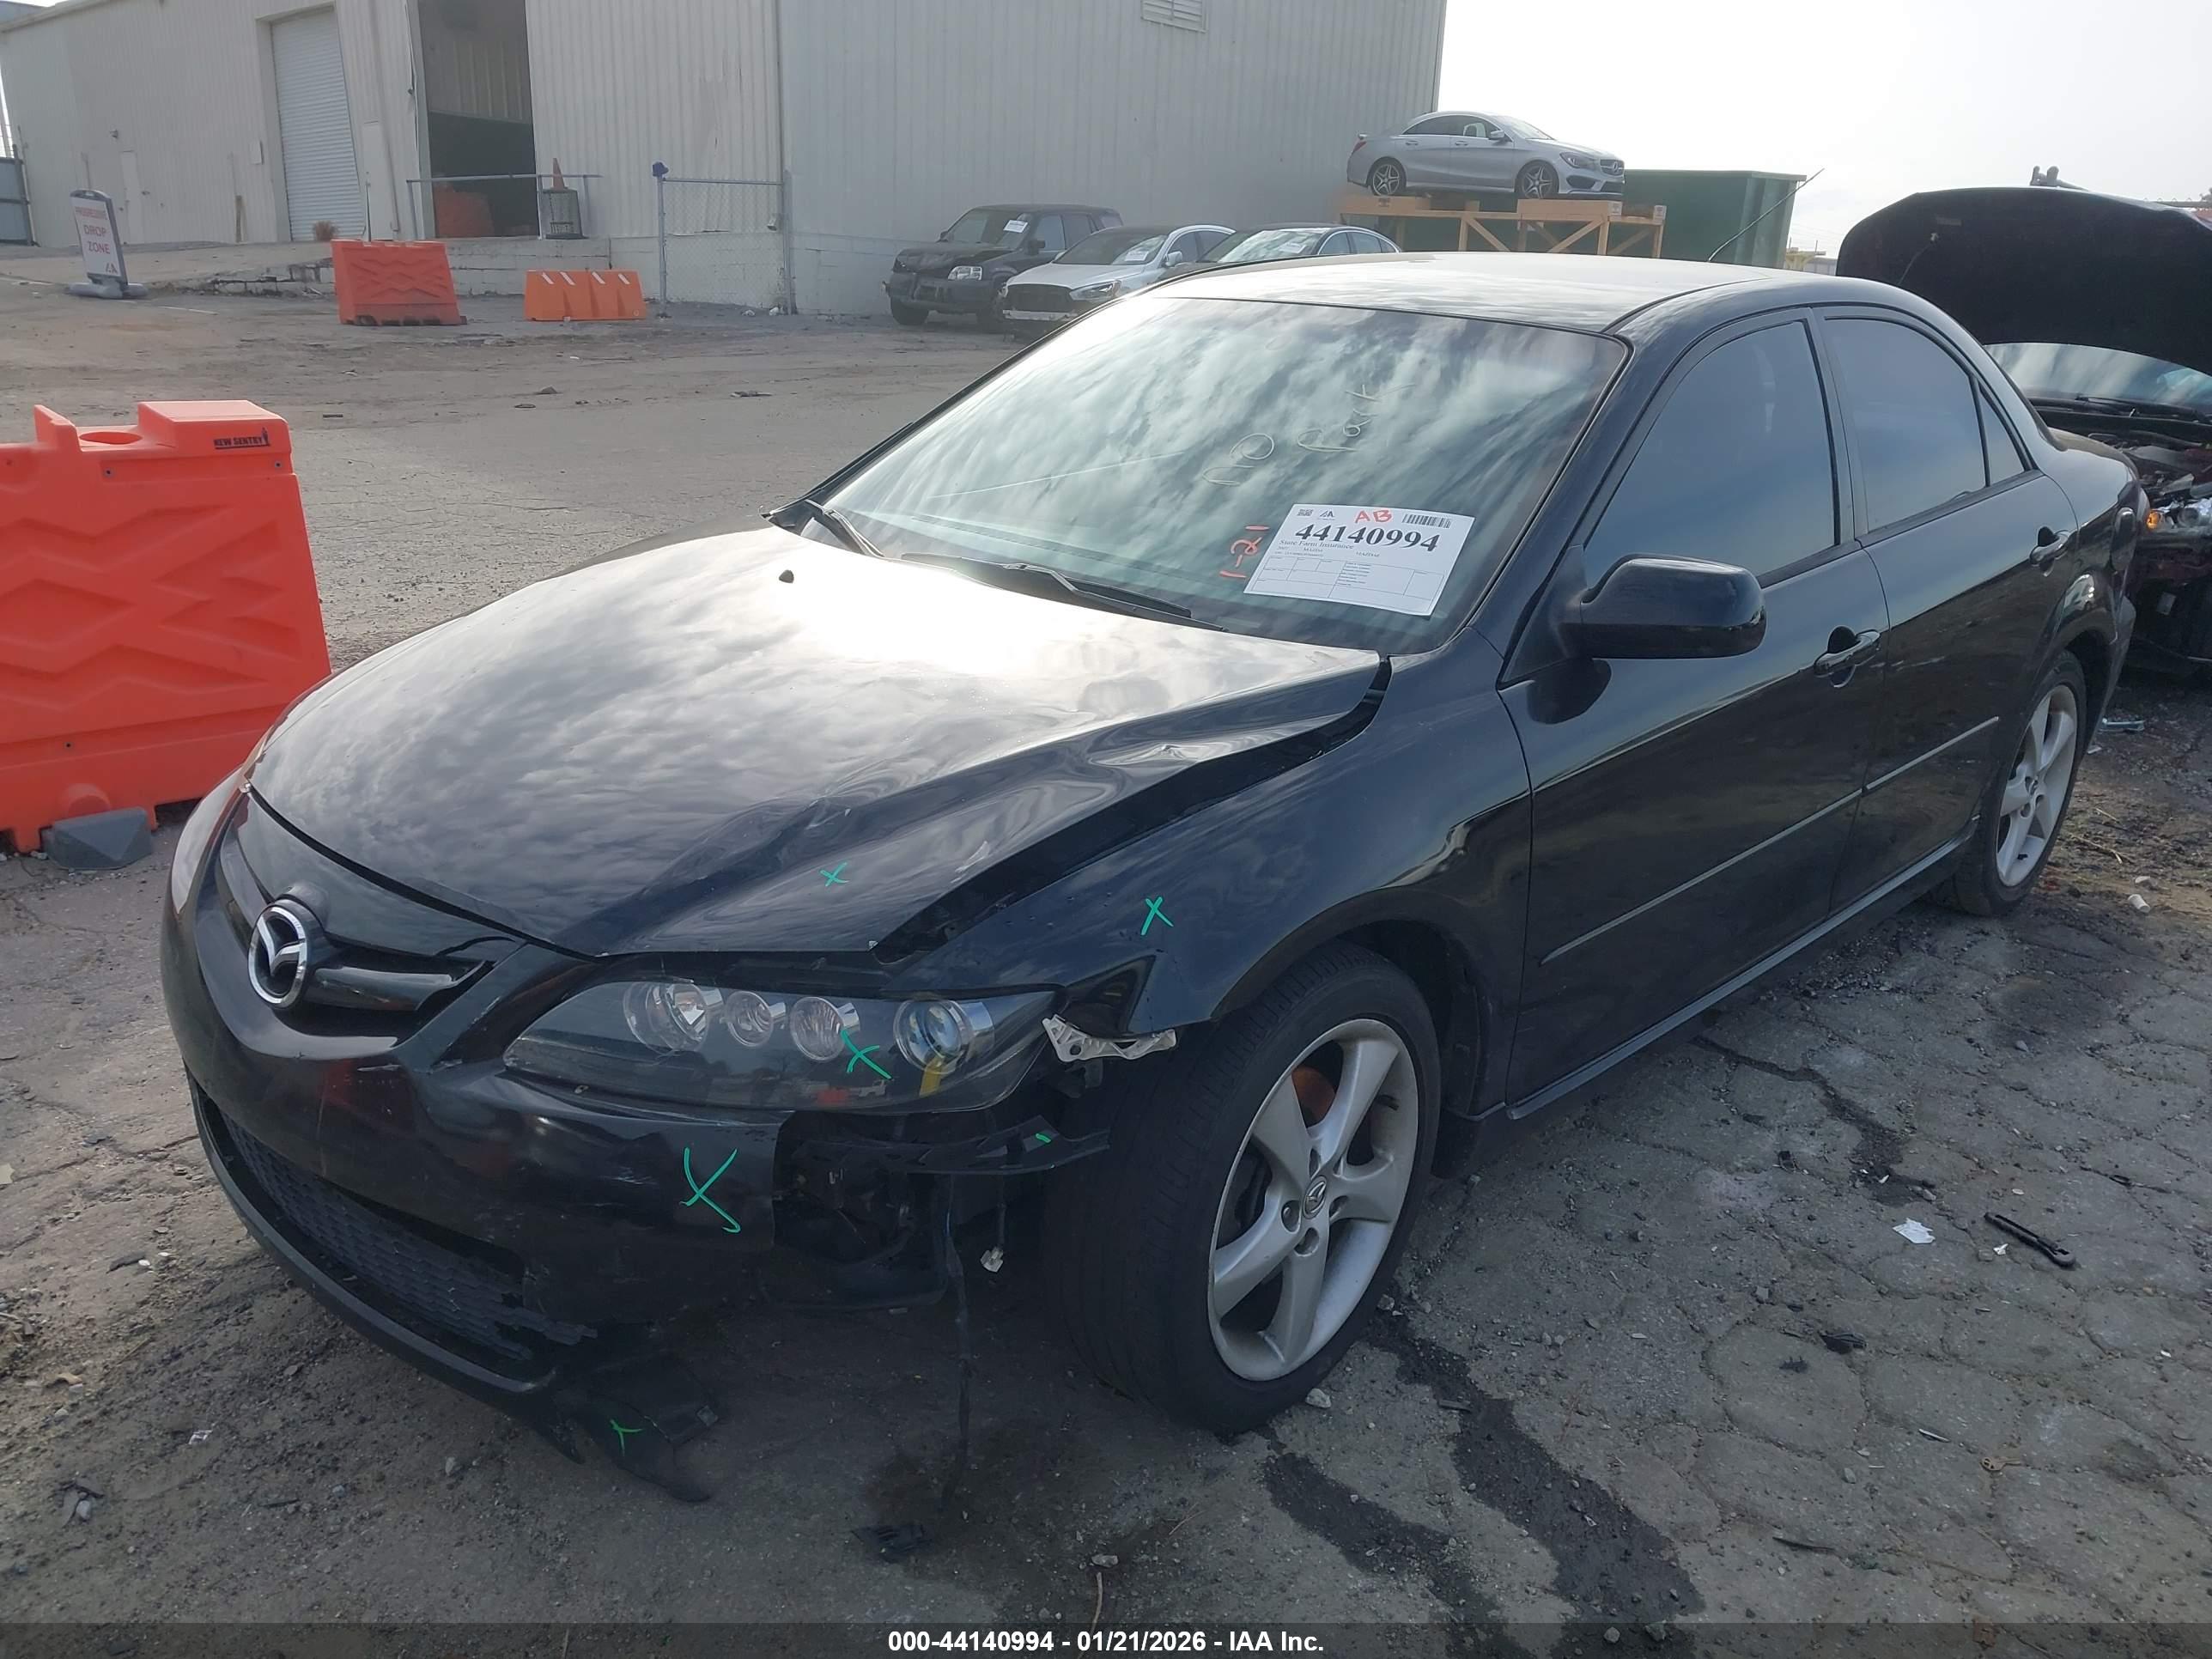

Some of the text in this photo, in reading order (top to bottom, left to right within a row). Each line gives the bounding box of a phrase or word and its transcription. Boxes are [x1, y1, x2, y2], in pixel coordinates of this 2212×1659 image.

[83, 225, 106, 237] DROP
[88, 241, 111, 254] ZONE
[214, 436, 263, 447] NEW SENTRY
[1355, 509, 1393, 524] AB
[1295, 524, 1441, 552] 44140994
